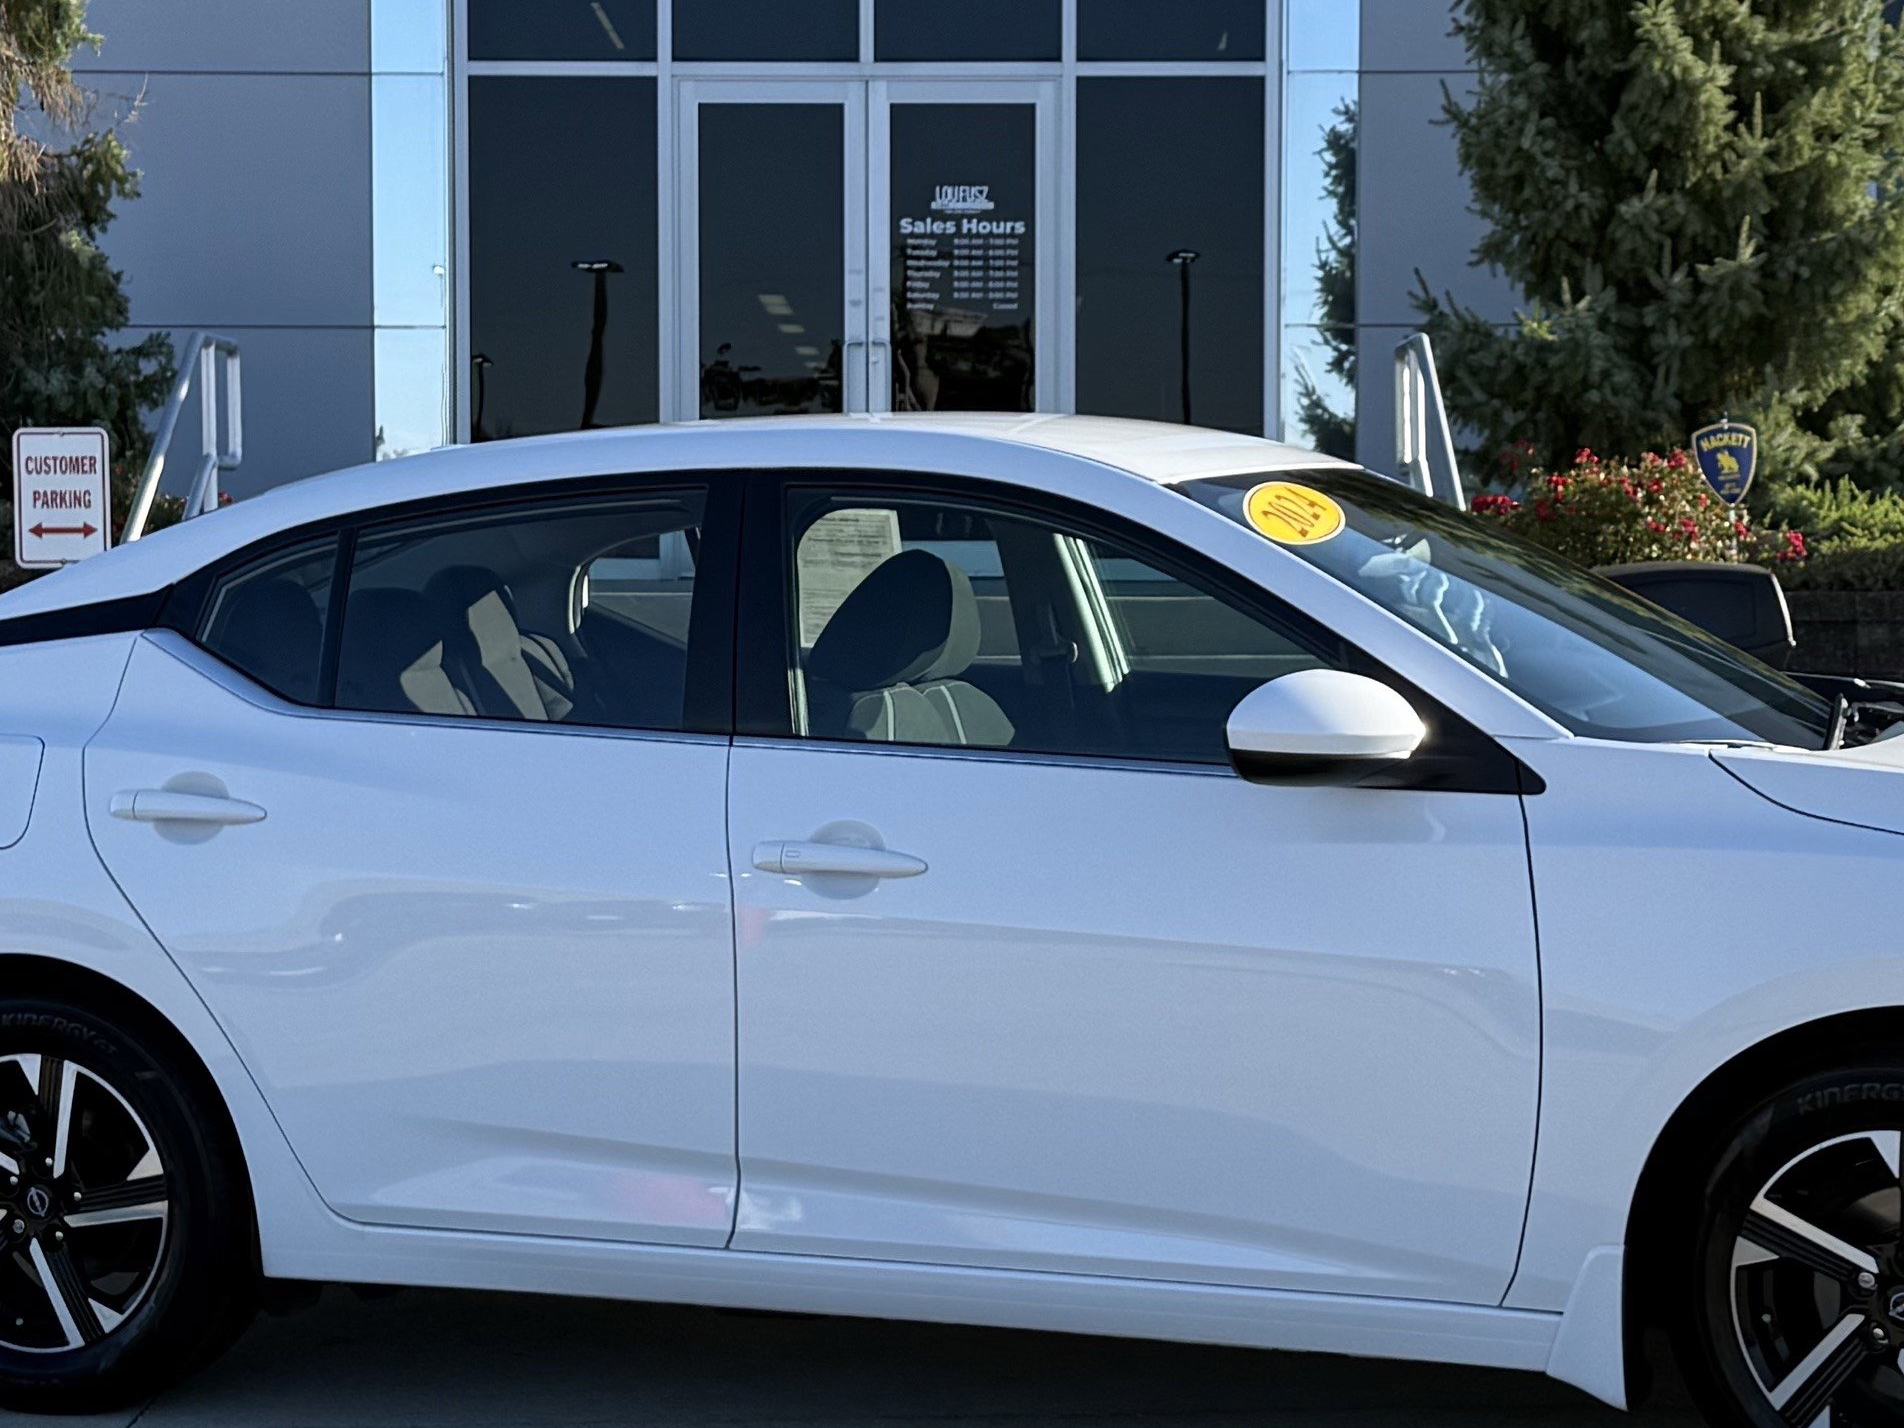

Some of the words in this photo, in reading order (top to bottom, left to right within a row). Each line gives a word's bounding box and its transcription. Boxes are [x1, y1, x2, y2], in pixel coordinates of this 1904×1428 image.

[899, 217, 956, 234] Sales
[962, 218, 1026, 234] Hours
[25, 455, 97, 476] CUSTOMER
[32, 489, 92, 509] PARKING
[1260, 486, 1327, 539] 2024
